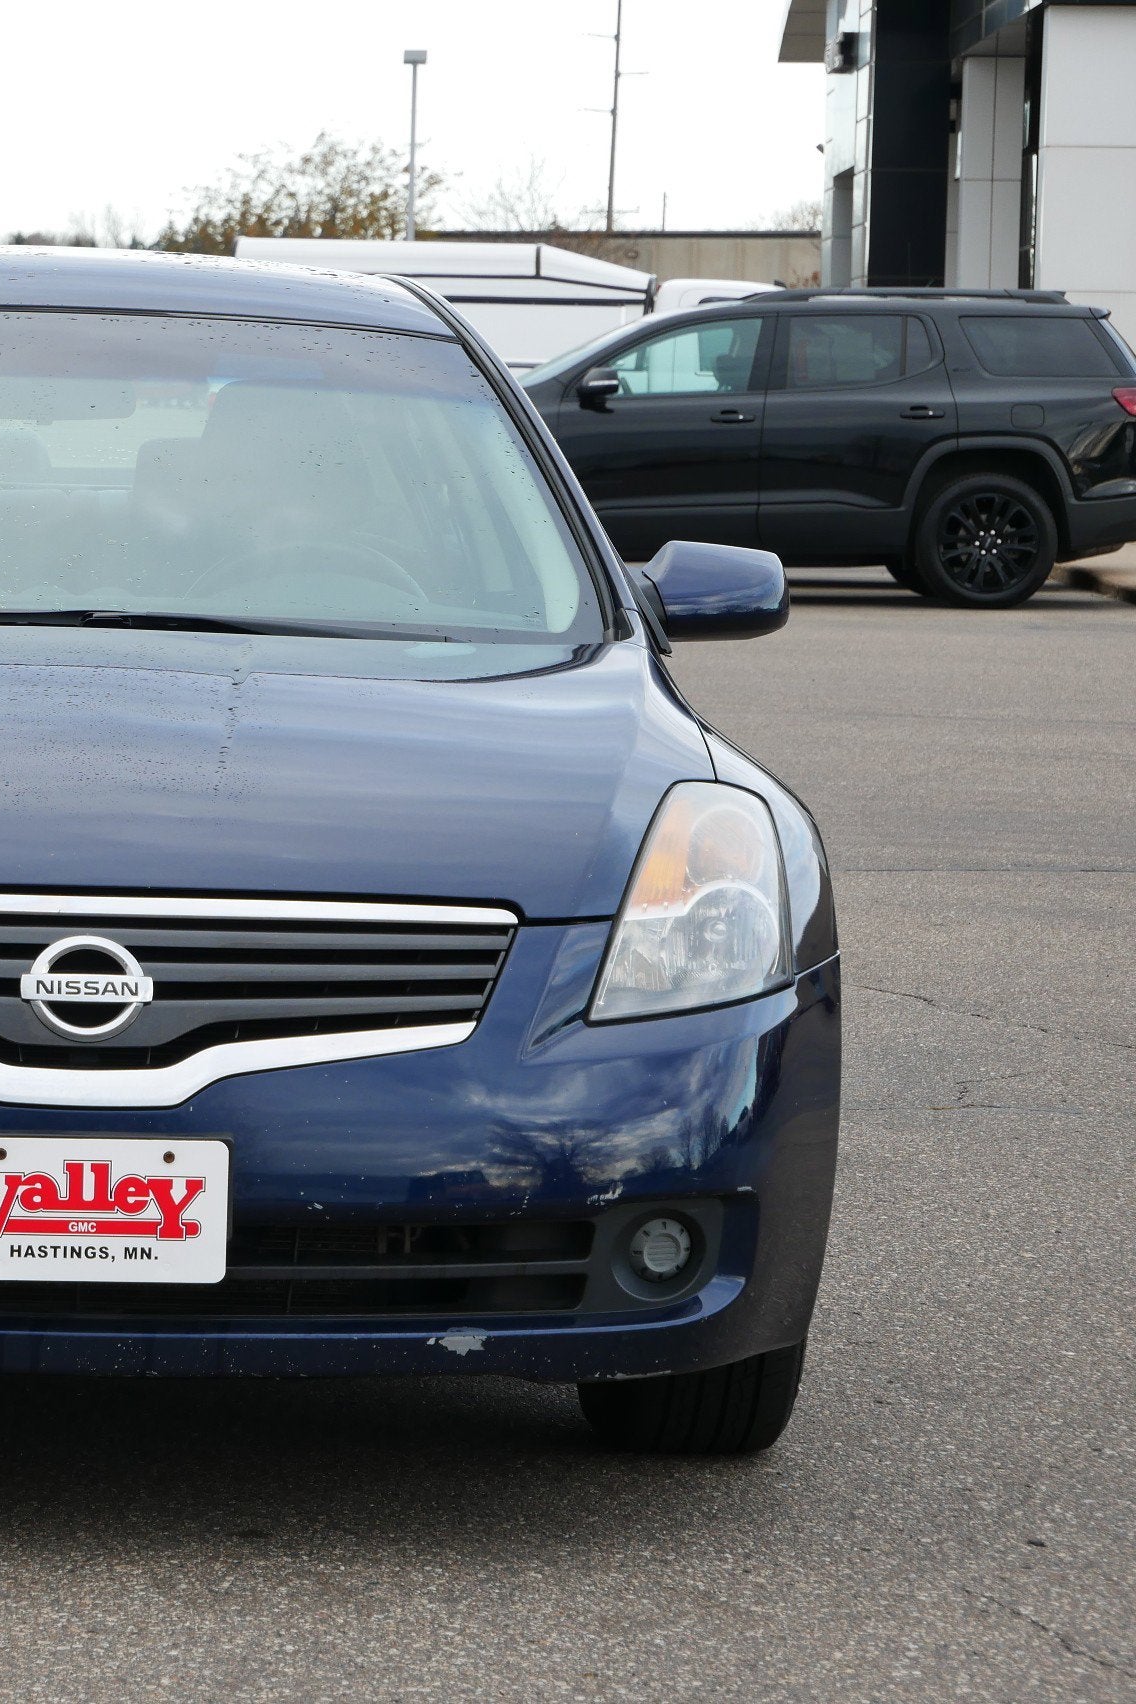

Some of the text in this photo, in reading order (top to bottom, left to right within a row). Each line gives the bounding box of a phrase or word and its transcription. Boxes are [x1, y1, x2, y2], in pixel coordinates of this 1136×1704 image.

[36, 979, 139, 997] NISSAN
[68, 1221, 97, 1233] GMC
[10, 1244, 159, 1262] HASTINGS, MN.
